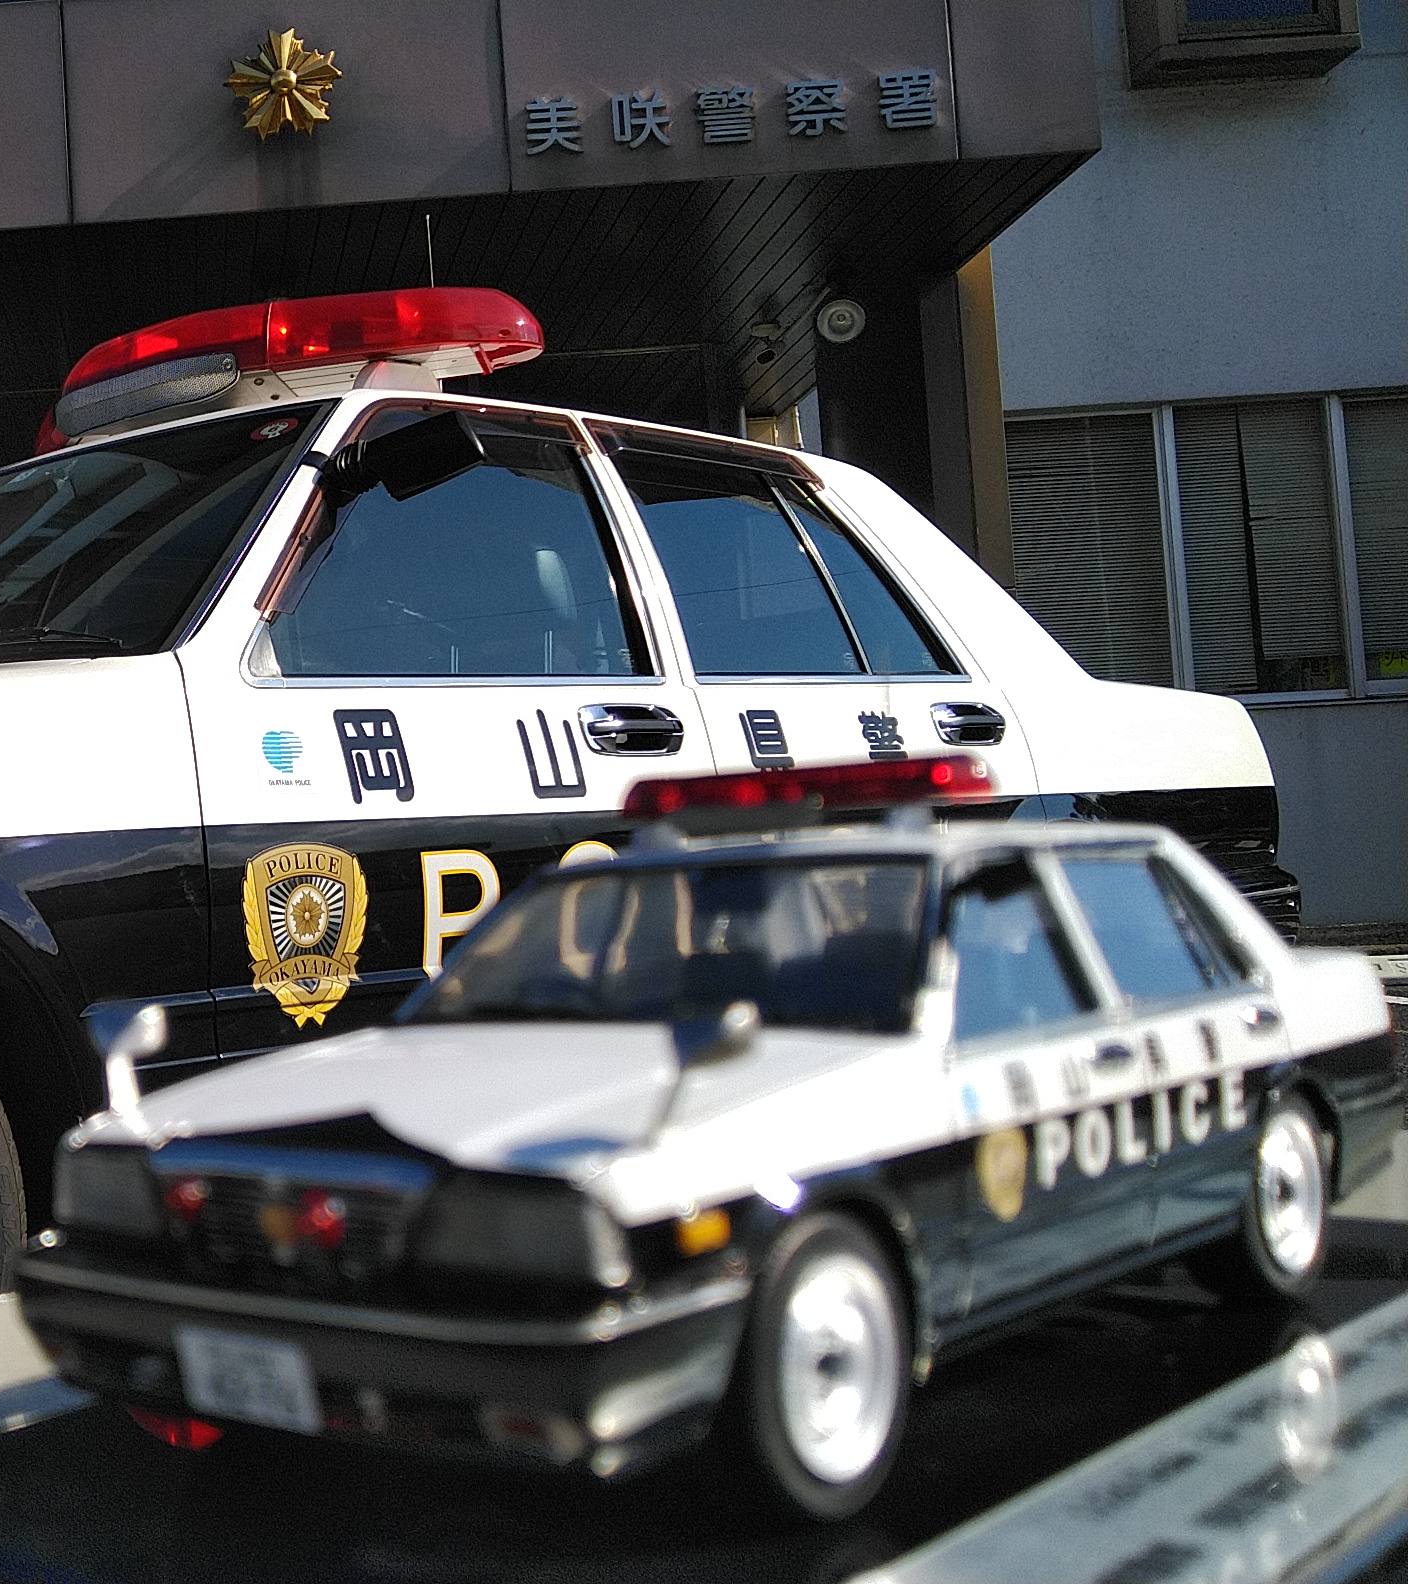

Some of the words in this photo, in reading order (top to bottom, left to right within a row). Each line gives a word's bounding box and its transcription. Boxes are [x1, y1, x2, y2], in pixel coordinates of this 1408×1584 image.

[526, 68, 938, 155] 美咲警察署
[265, 852, 341, 878] POLICE
[269, 958, 341, 987] OKAYAMA
[1033, 1066, 1248, 1190] POLICE
